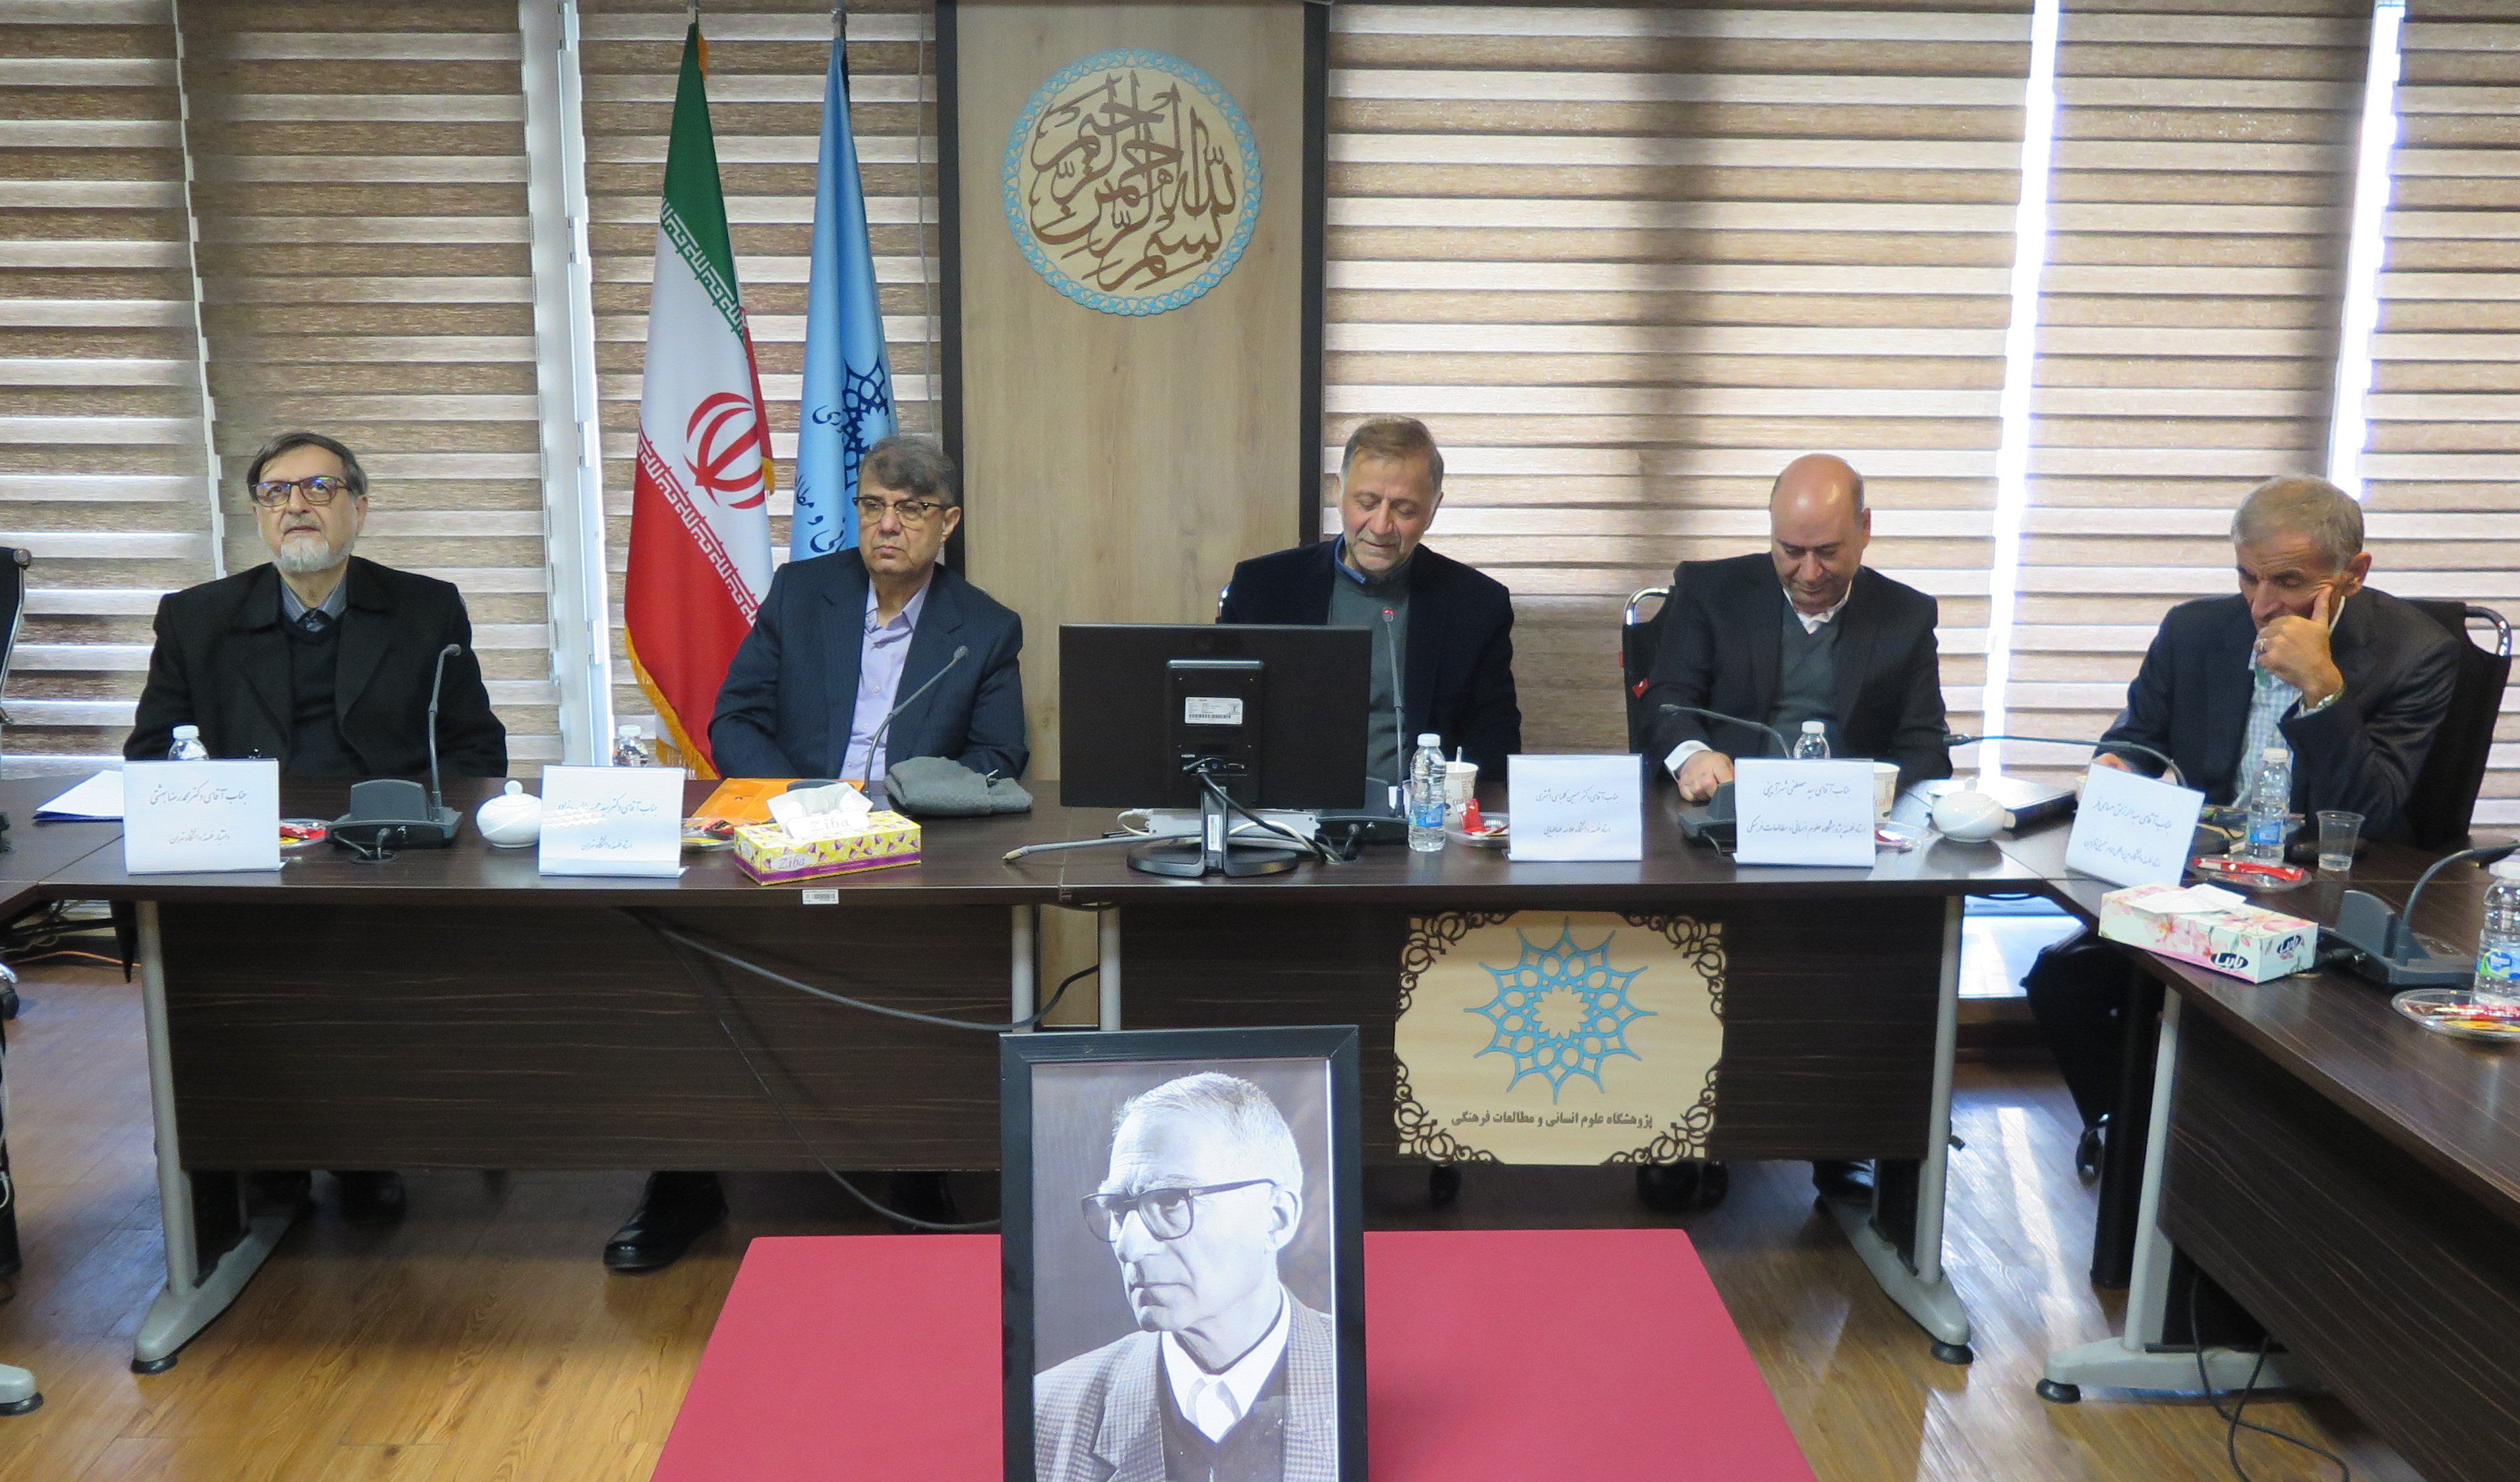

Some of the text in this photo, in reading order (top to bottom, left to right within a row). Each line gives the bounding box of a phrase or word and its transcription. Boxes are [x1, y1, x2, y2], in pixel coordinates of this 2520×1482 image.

[810, 818, 850, 833] Ziba
[777, 852, 806, 870] Ziba
[1451, 1110, 1654, 1129] پژوهشگاه علوم انسانی و مطالعات فرهنگی
